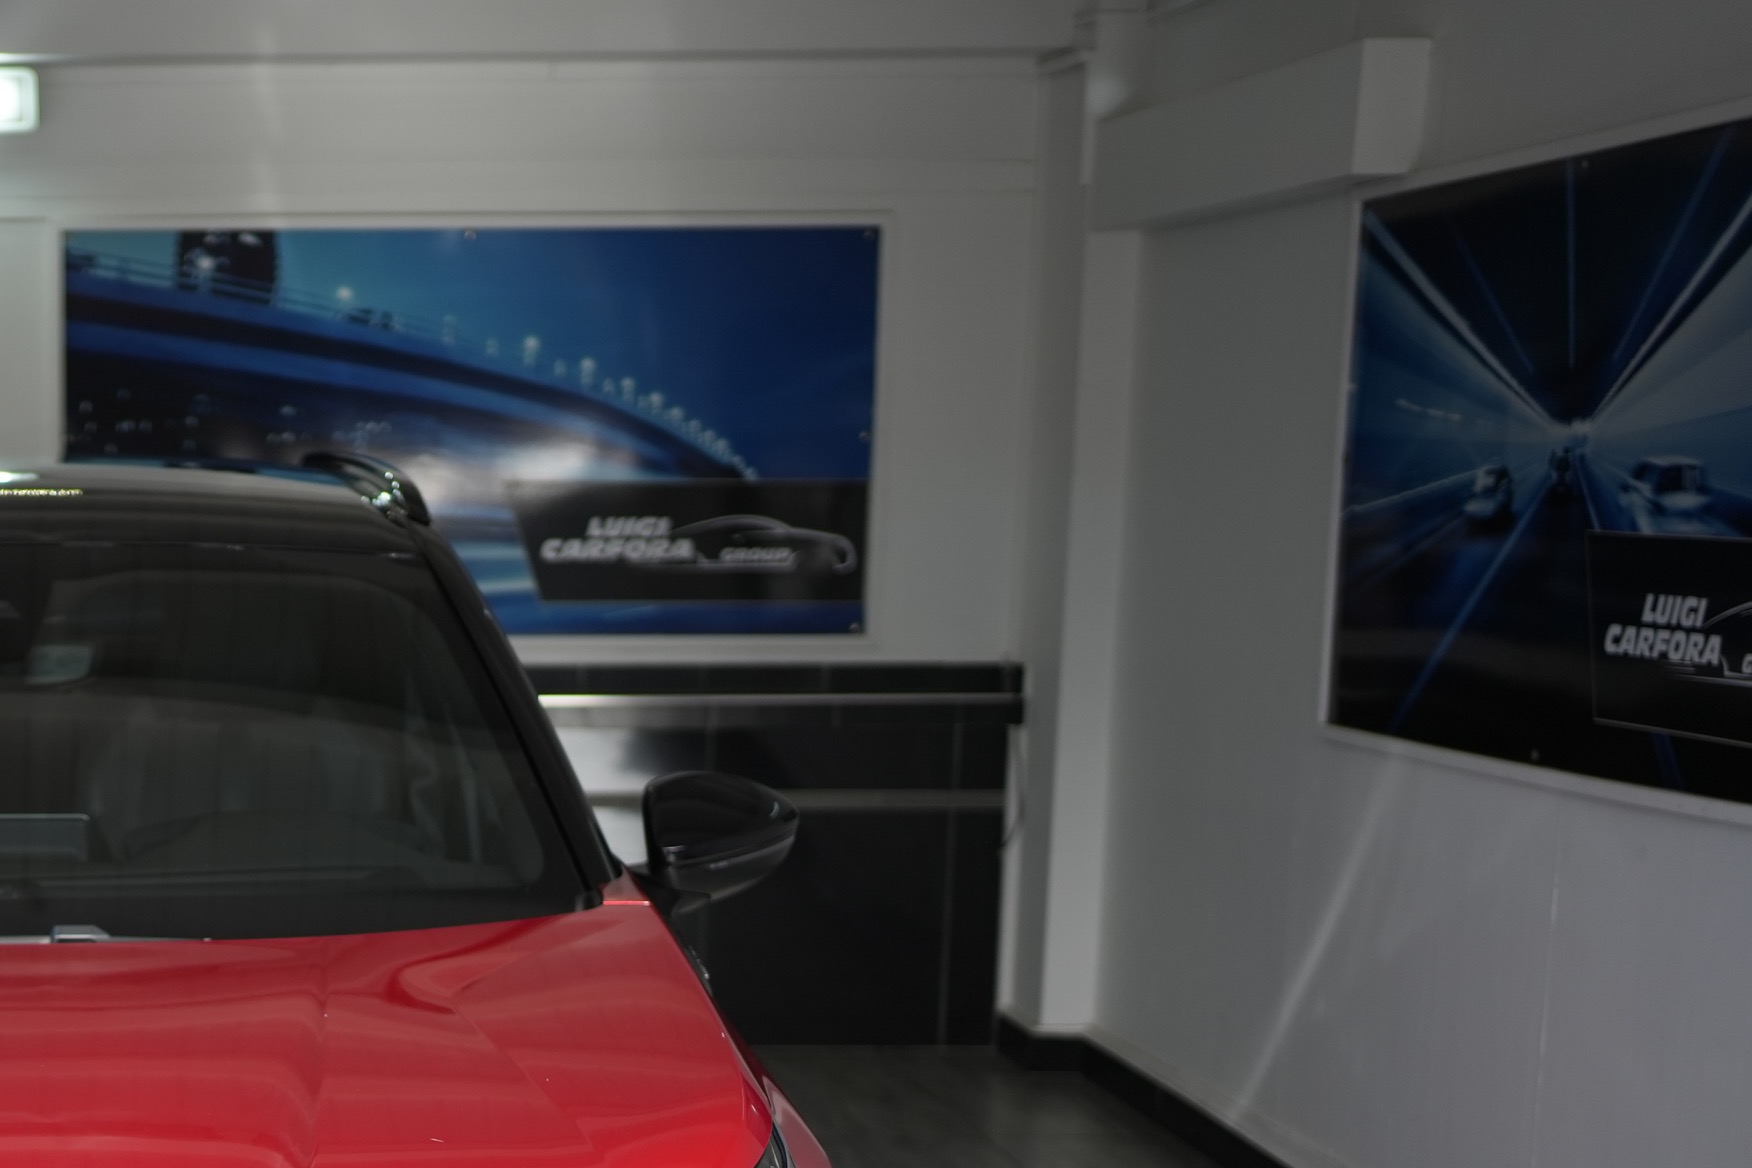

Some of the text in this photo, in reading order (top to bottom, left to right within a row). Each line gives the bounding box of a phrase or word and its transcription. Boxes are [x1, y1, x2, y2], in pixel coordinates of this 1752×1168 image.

[587, 517, 672, 537] LUIGI
[540, 539, 792, 562] CARFORA GROUP
[1641, 593, 1708, 628] LUIGI
[1604, 624, 1722, 667] CARFORA
